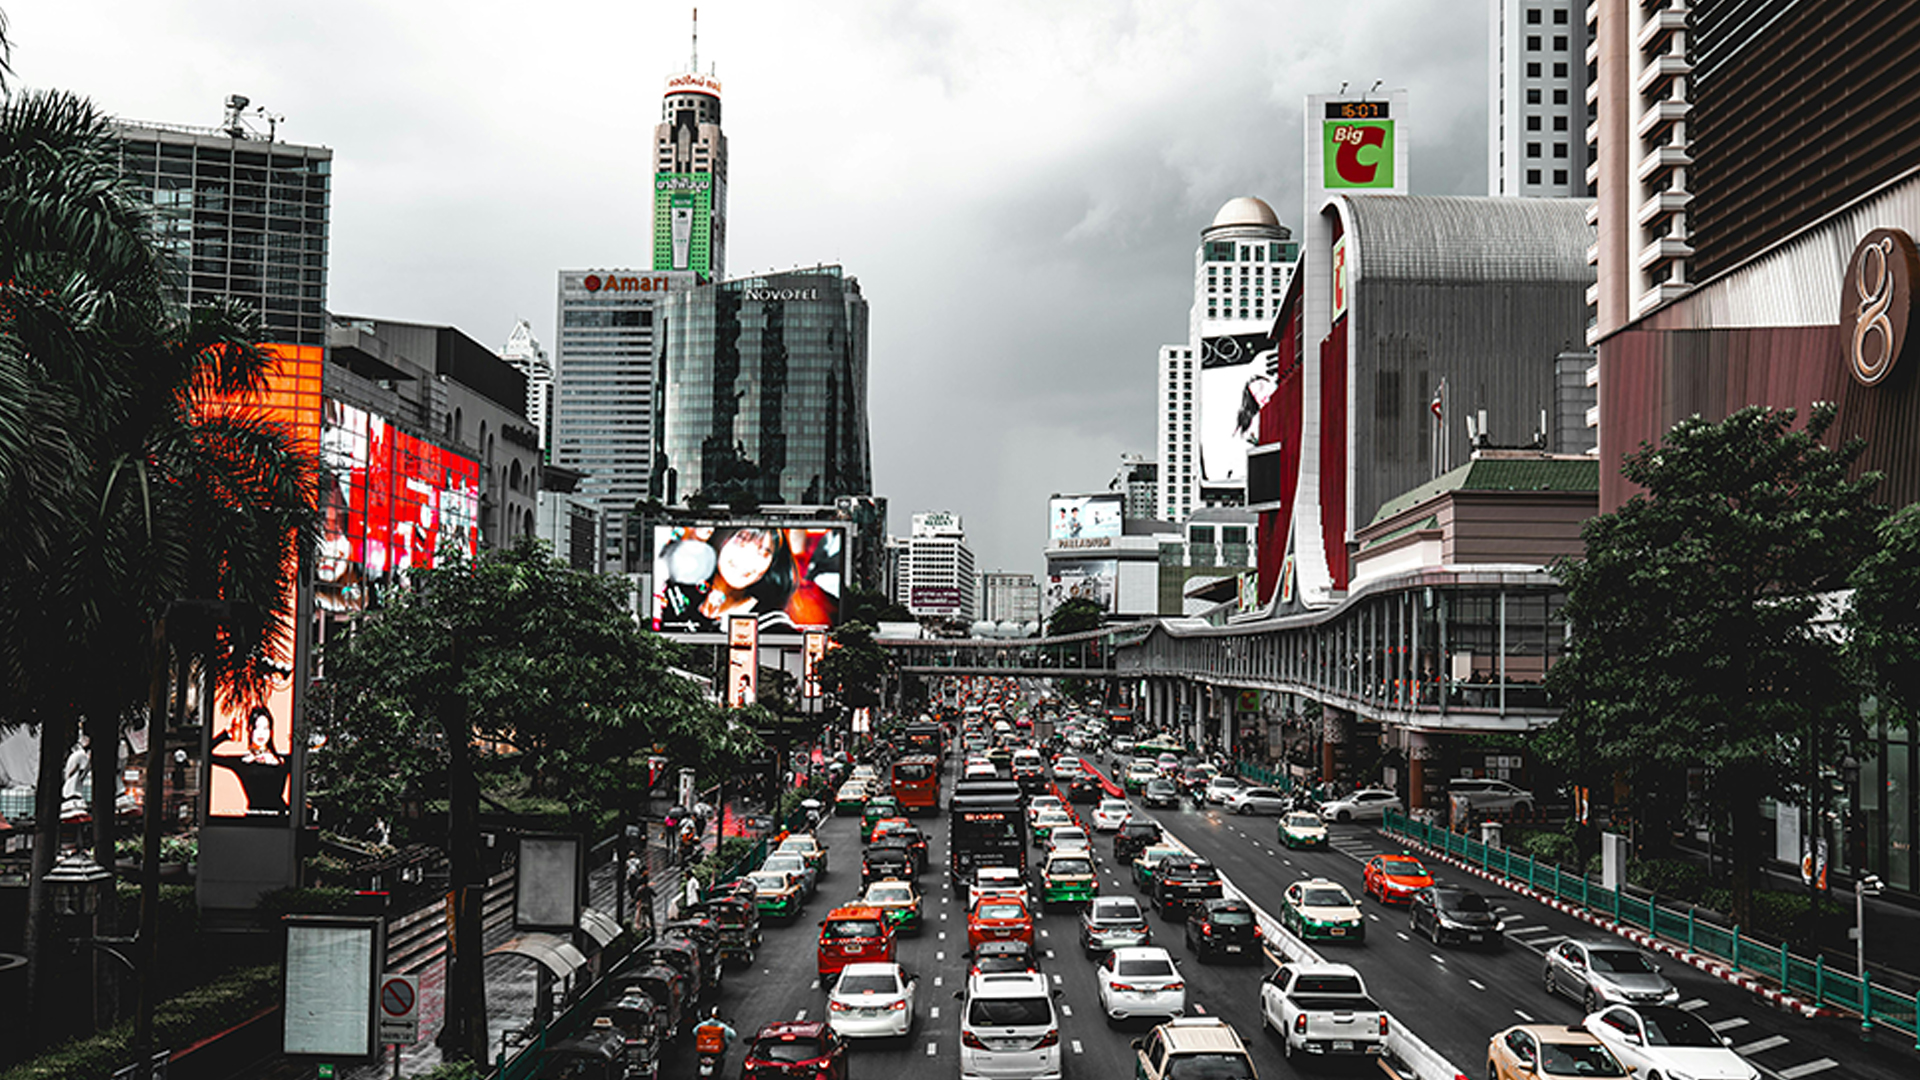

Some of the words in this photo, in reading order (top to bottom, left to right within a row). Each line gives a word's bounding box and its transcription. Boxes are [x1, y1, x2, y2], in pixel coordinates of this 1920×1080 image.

[1341, 103, 1378, 118] 16:07
[1335, 125, 1364, 145] Big
[1335, 126, 1386, 183] C
[603, 274, 669, 292] Amari
[745, 288, 820, 301] NOVOTEL
